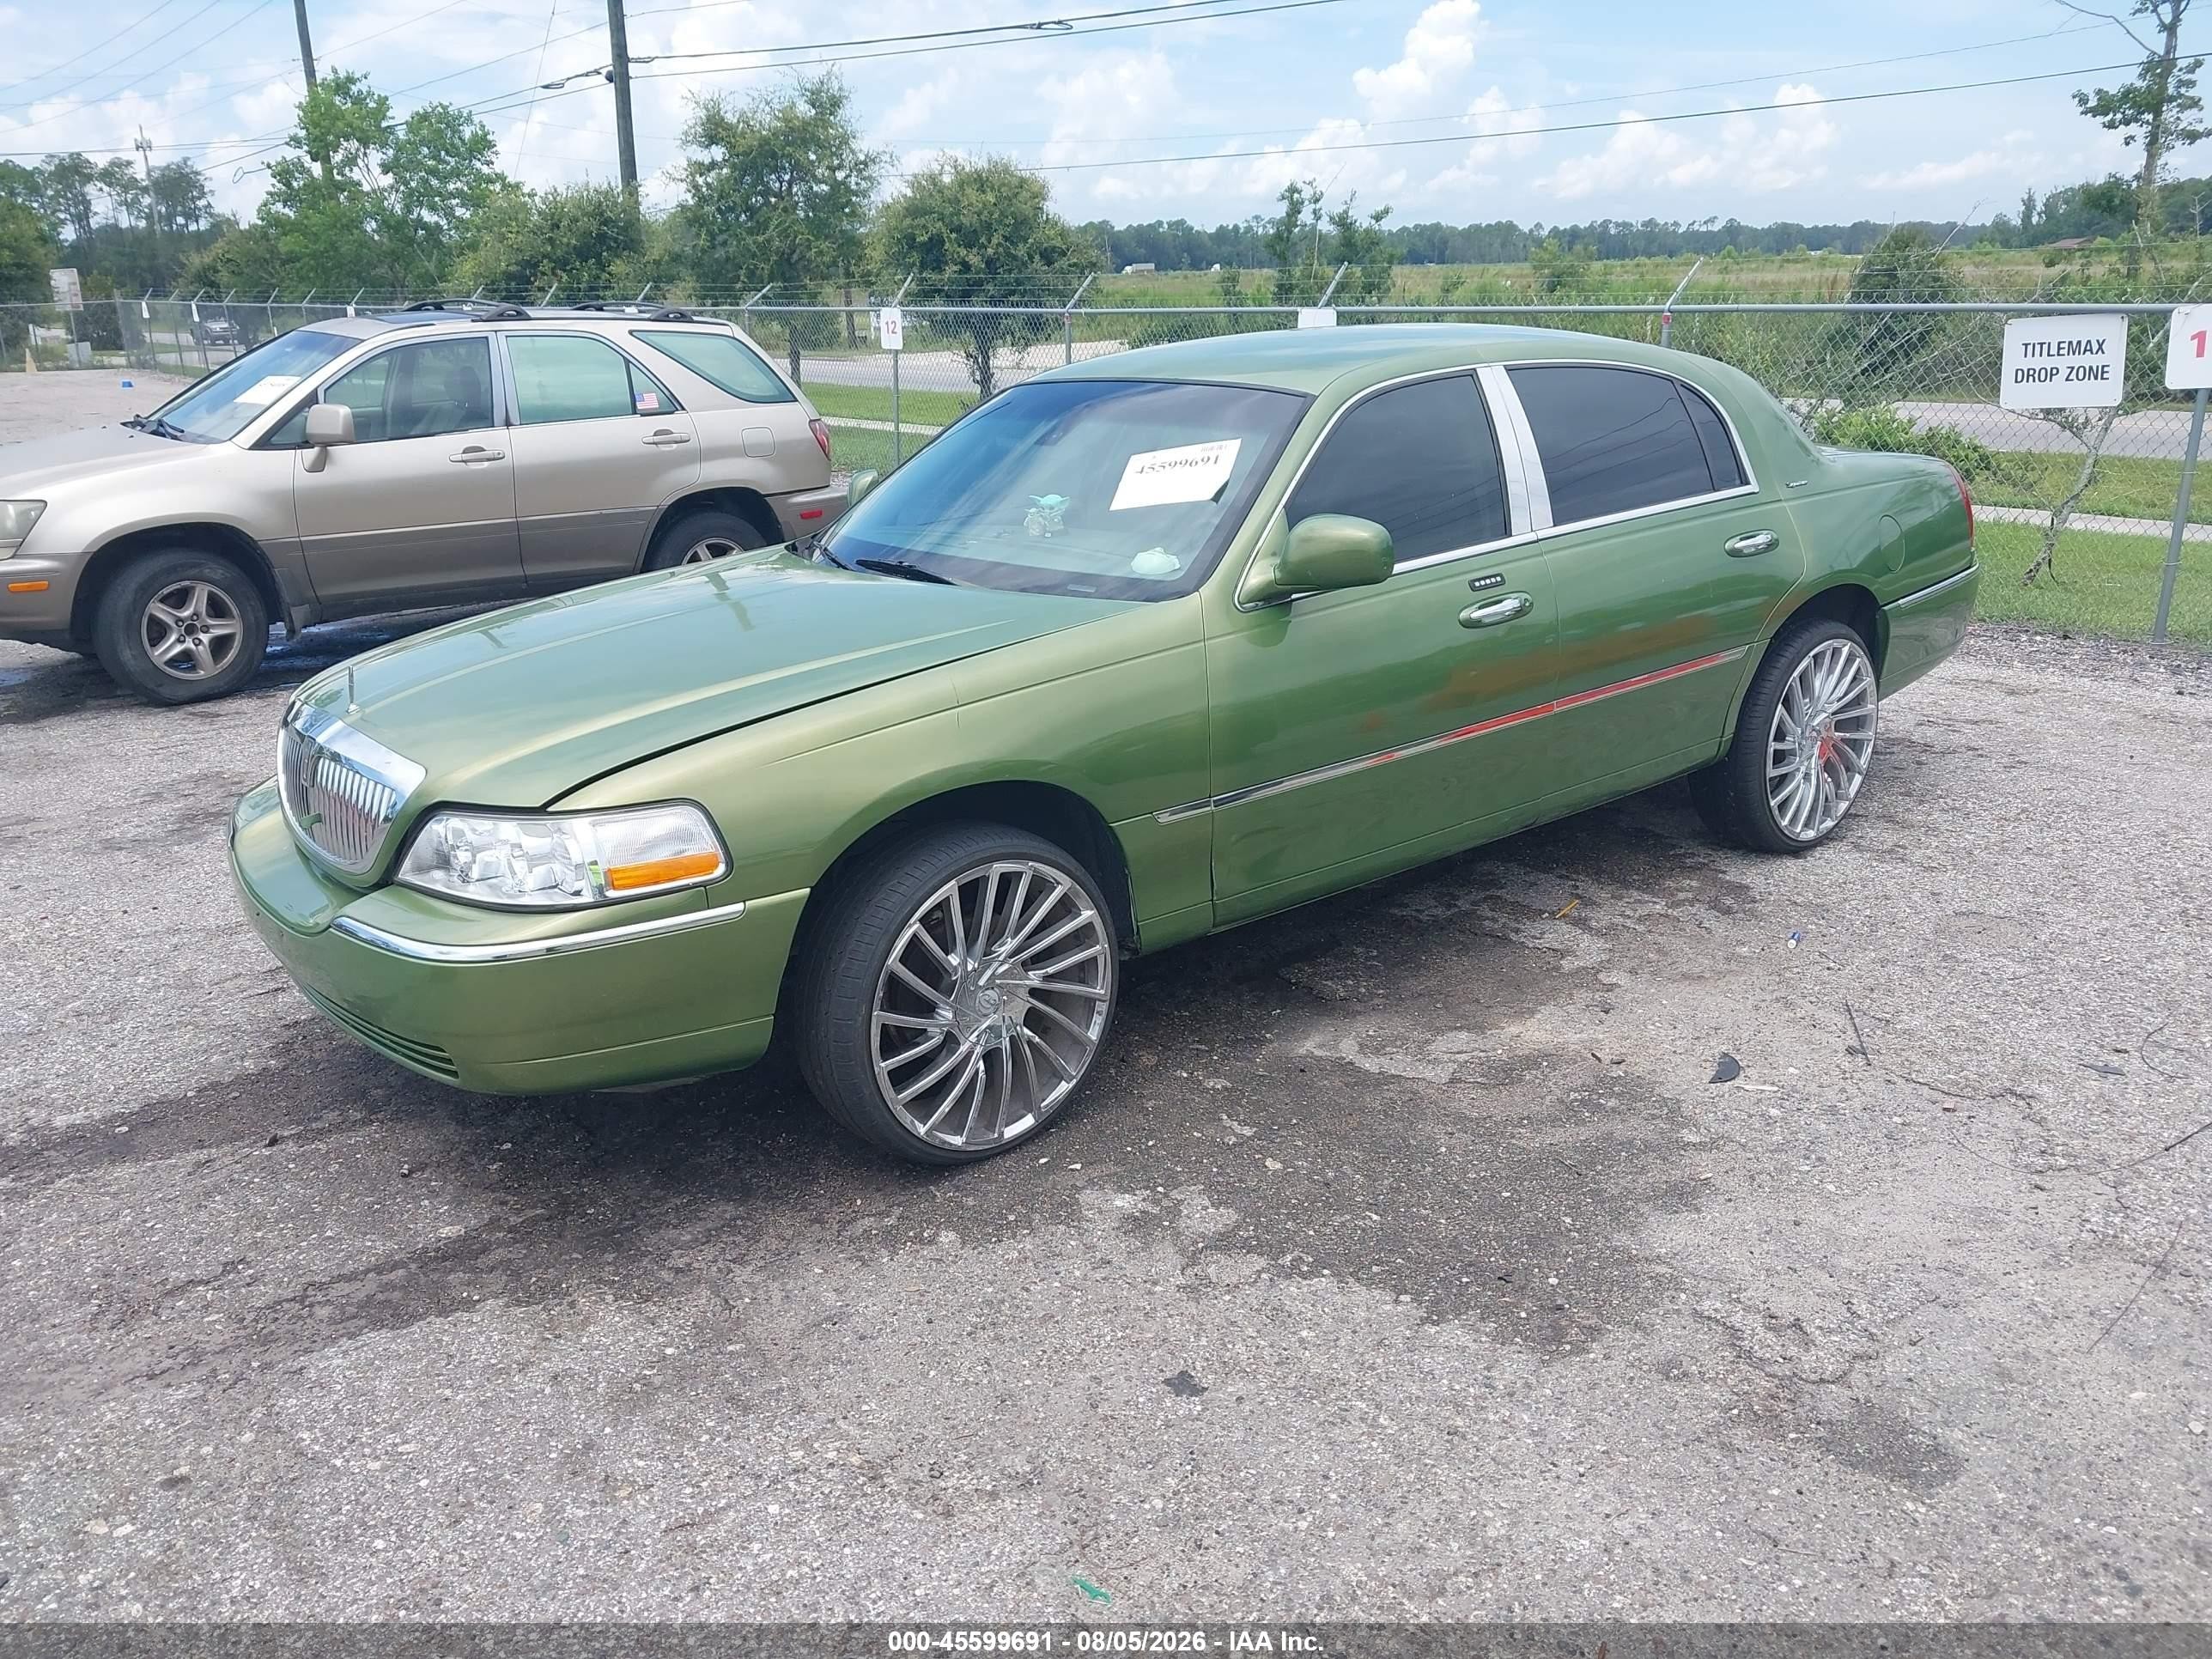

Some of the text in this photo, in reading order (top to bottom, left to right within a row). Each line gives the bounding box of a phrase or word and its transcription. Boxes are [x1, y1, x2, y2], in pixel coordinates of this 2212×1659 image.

[884, 319, 898, 335] 12
[2021, 337, 2107, 359] TITLEMAX
[2190, 329, 2208, 359] 1
[2014, 363, 2111, 385] DROP ZONE
